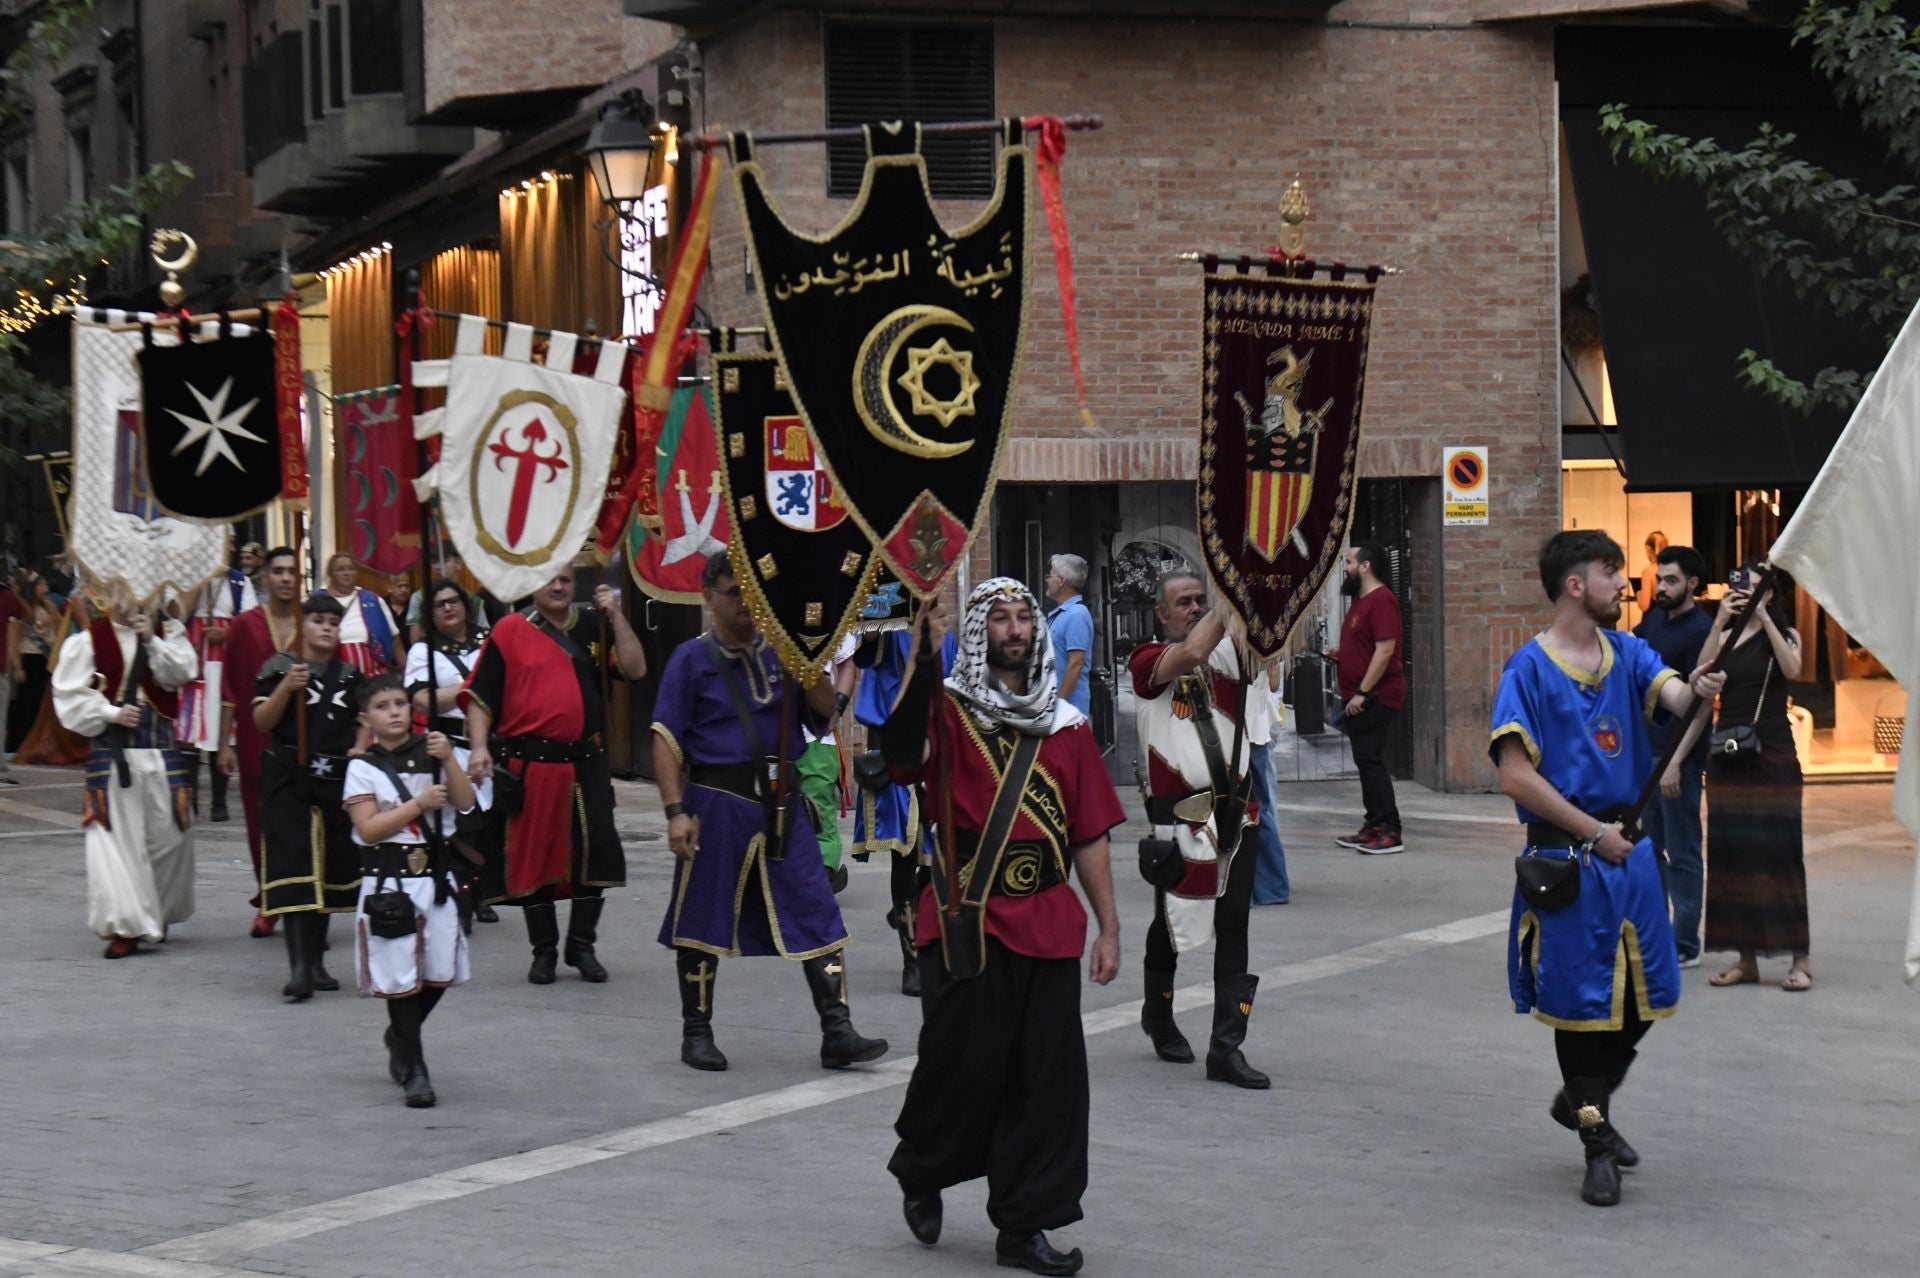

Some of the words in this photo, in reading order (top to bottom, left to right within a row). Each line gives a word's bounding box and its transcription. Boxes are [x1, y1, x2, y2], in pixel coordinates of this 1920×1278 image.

[623, 290, 664, 346] ARC
[1296, 323, 1344, 341] JAIME
[278, 326, 297, 419] MURCIA
[287, 432, 301, 491] 1200
